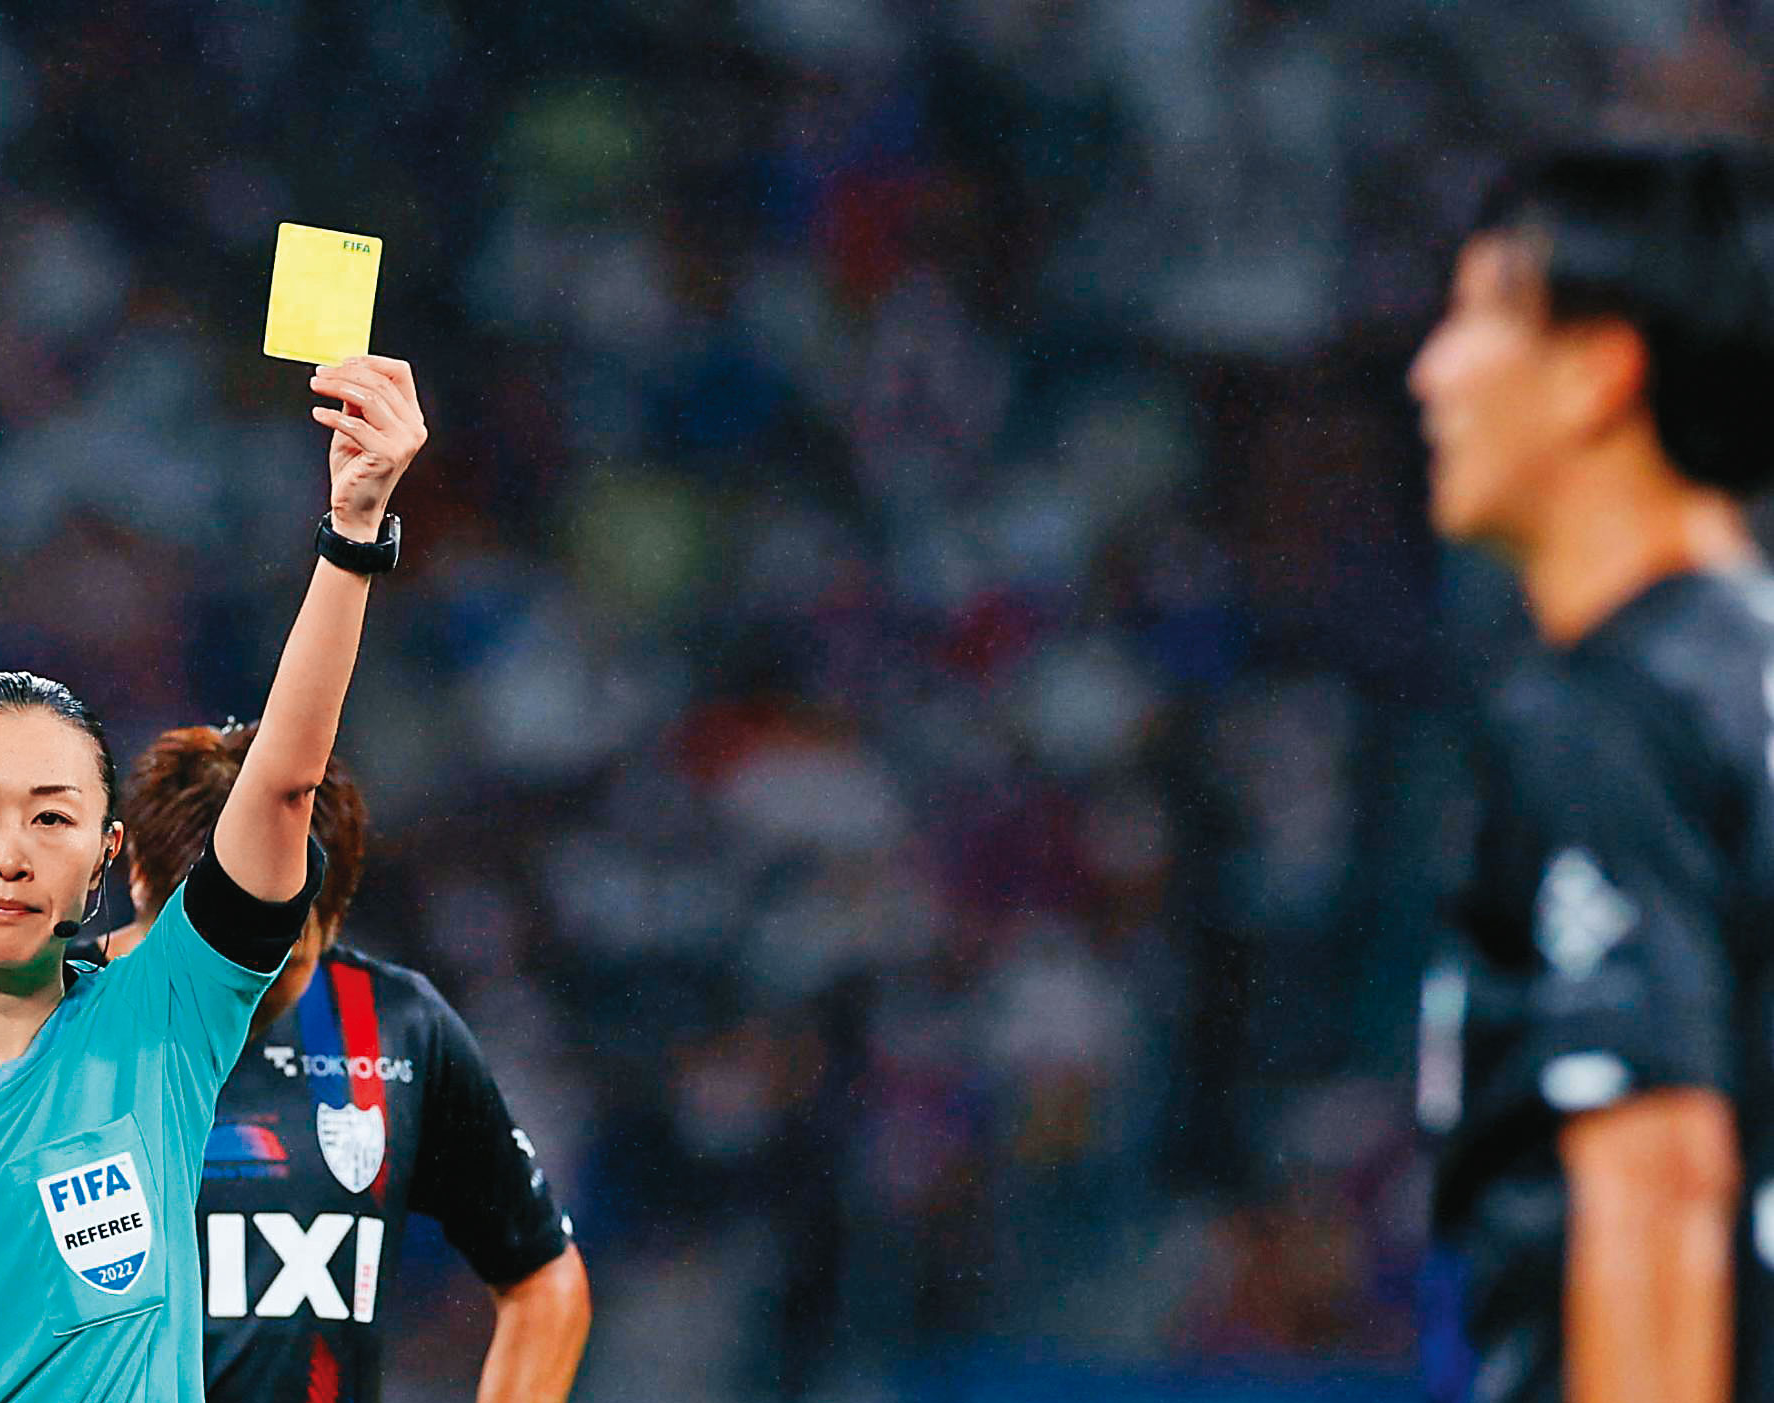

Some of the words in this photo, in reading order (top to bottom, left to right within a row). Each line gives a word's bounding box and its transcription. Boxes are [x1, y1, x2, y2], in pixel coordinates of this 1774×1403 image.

[343, 240, 371, 253] FIFA
[49, 1164, 131, 1213] FIFA
[64, 1212, 143, 1250] REFEREE
[98, 1261, 135, 1284] 2022
[207, 1212, 385, 1323] IXI
